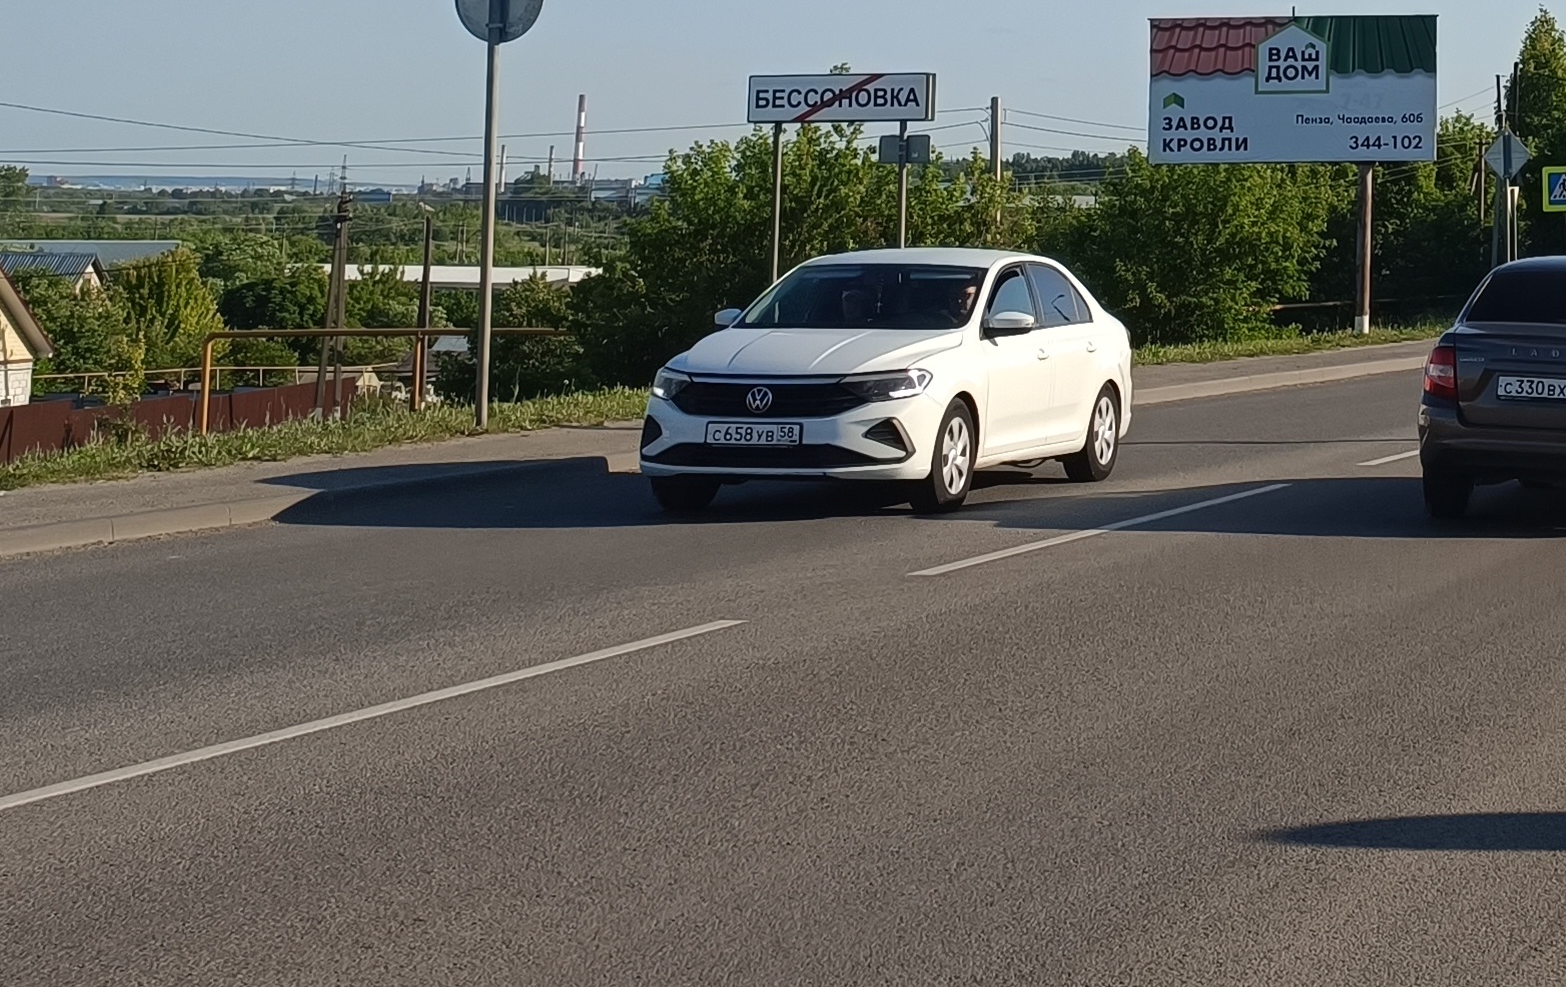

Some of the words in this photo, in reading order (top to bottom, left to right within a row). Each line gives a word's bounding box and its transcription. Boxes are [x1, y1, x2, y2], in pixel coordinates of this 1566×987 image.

[1268, 46, 1320, 63] ВАШ
[1265, 64, 1320, 83] ДОМ
[755, 87, 920, 109] БЕССОНОВКА
[1162, 116, 1234, 133] ЗАВОД
[1296, 114, 1333, 126] Пенза,
[1337, 114, 1398, 125] Чаадаева,
[1162, 137, 1248, 152] КРОВЛИ
[1349, 135, 1423, 150] 344-102
